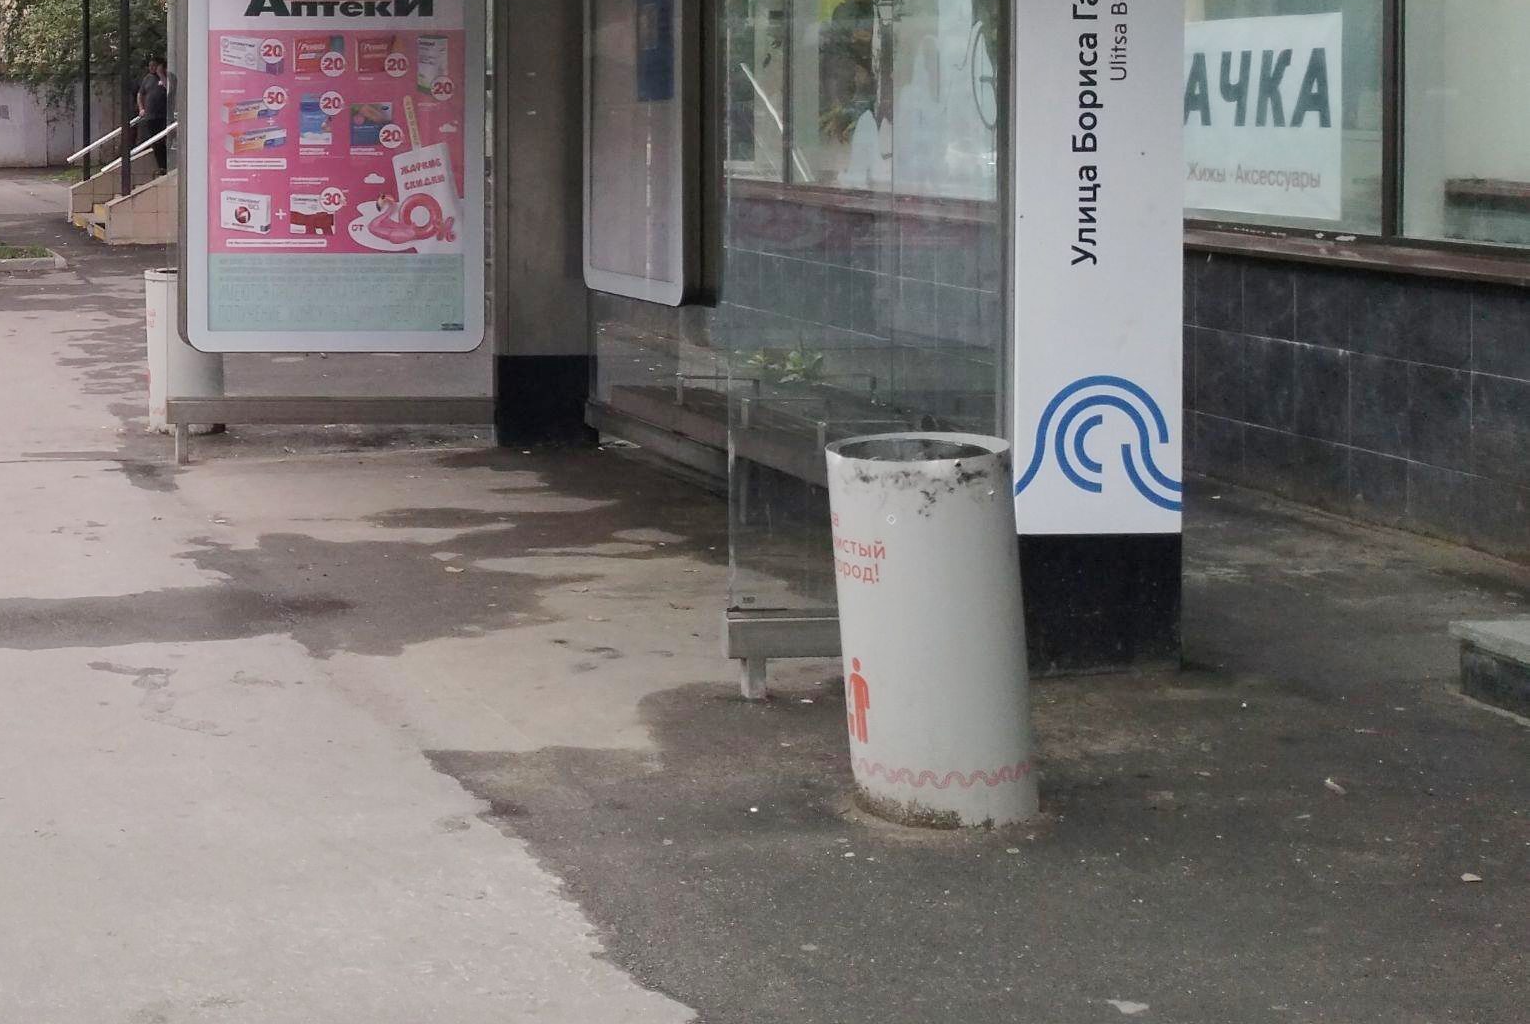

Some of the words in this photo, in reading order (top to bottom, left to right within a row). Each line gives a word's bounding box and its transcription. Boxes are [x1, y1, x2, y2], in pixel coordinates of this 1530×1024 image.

[1110, 23, 1128, 81] Ulitsa
[1071, 32, 1104, 153] Бориса
[1183, 47, 1332, 128] АЧКА
[1234, 163, 1321, 192] Аксессуары
[1071, 165, 1101, 266] Улица
[833, 536, 886, 560] истый
